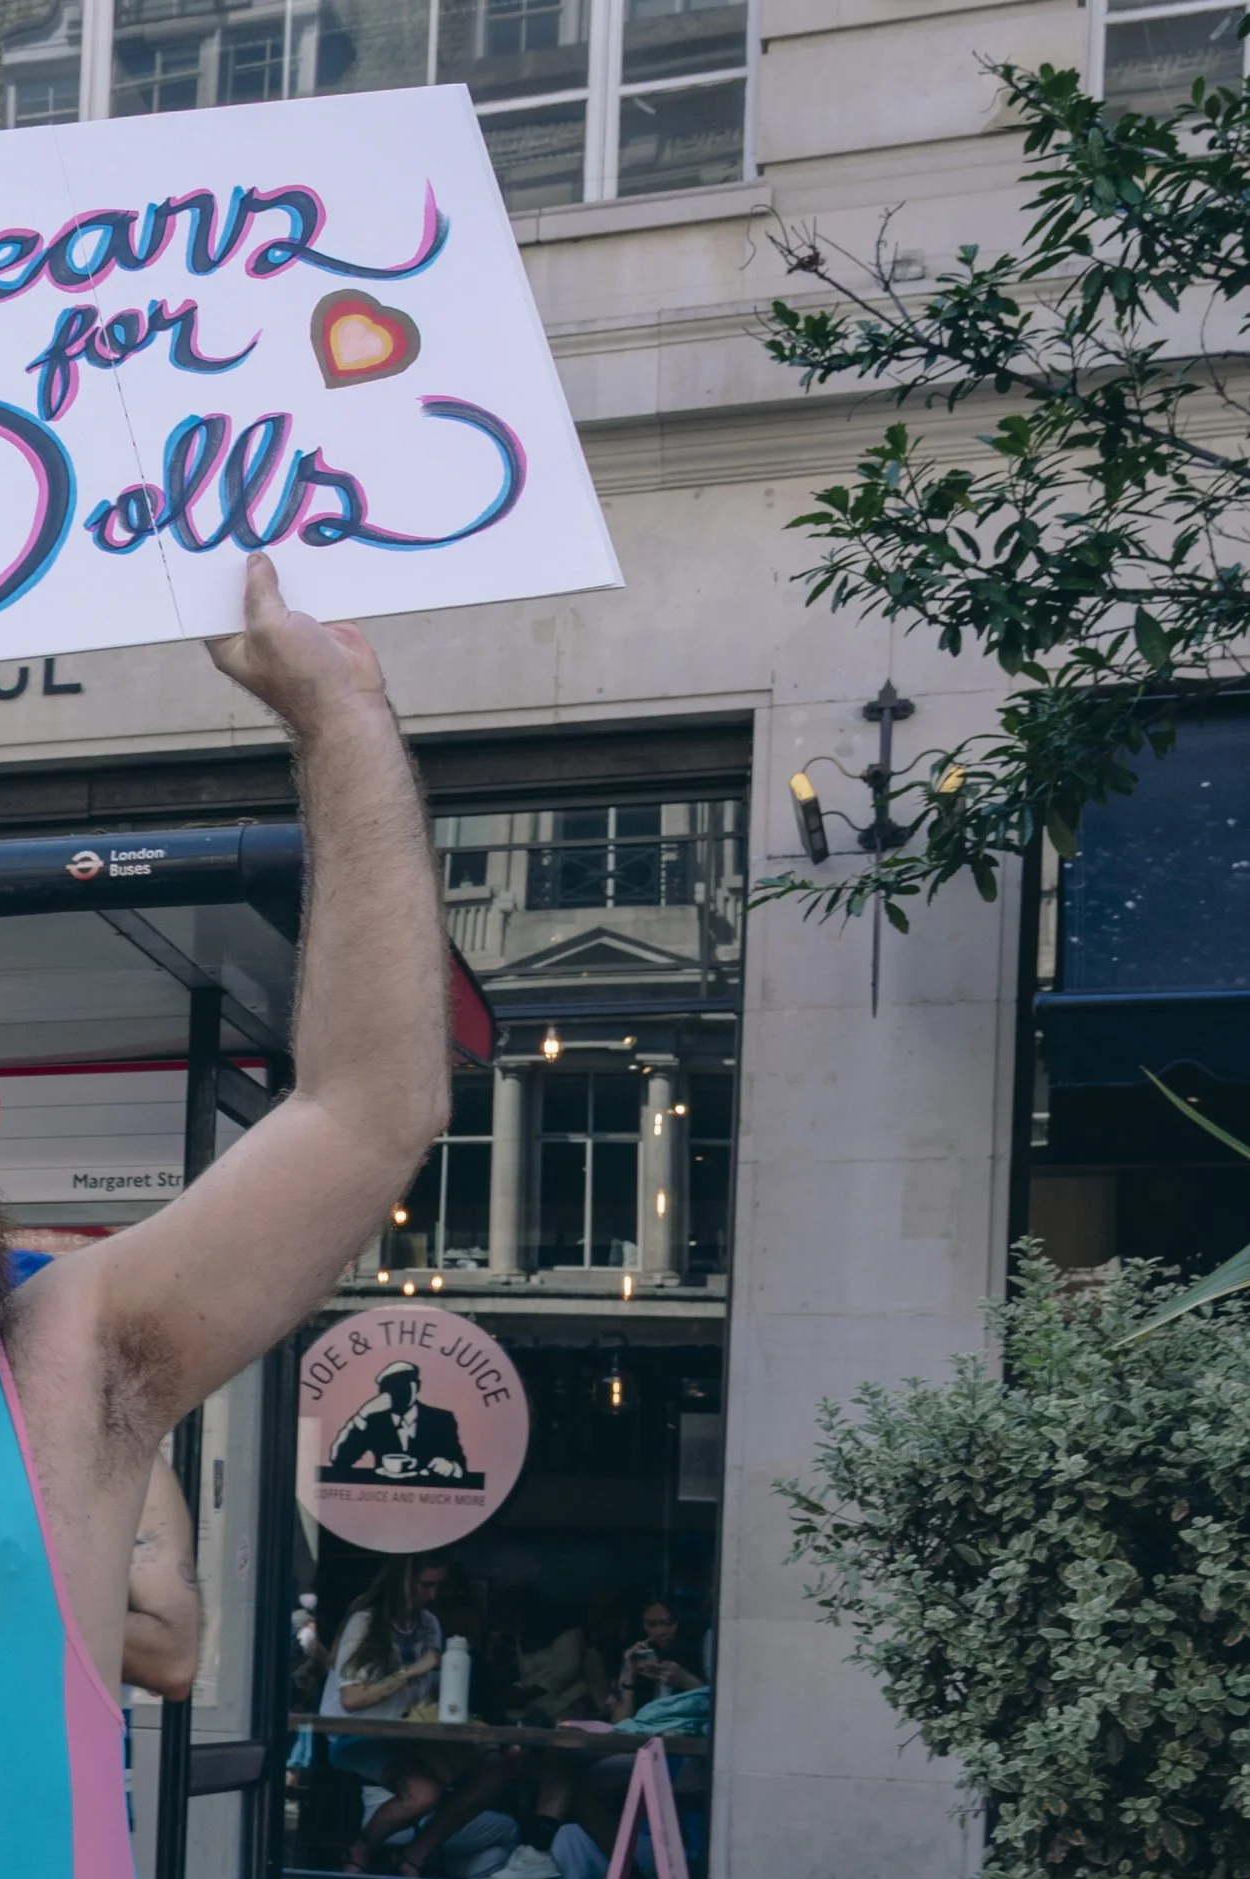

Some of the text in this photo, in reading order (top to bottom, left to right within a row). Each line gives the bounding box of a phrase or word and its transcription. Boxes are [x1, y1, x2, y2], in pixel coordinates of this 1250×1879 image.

[25, 297, 262, 422] for
[110, 847, 166, 861] London
[109, 864, 152, 877] Buses
[72, 1172, 183, 1192] Margaret Str
[300, 1319, 511, 1408] JOE & THE JUICE
